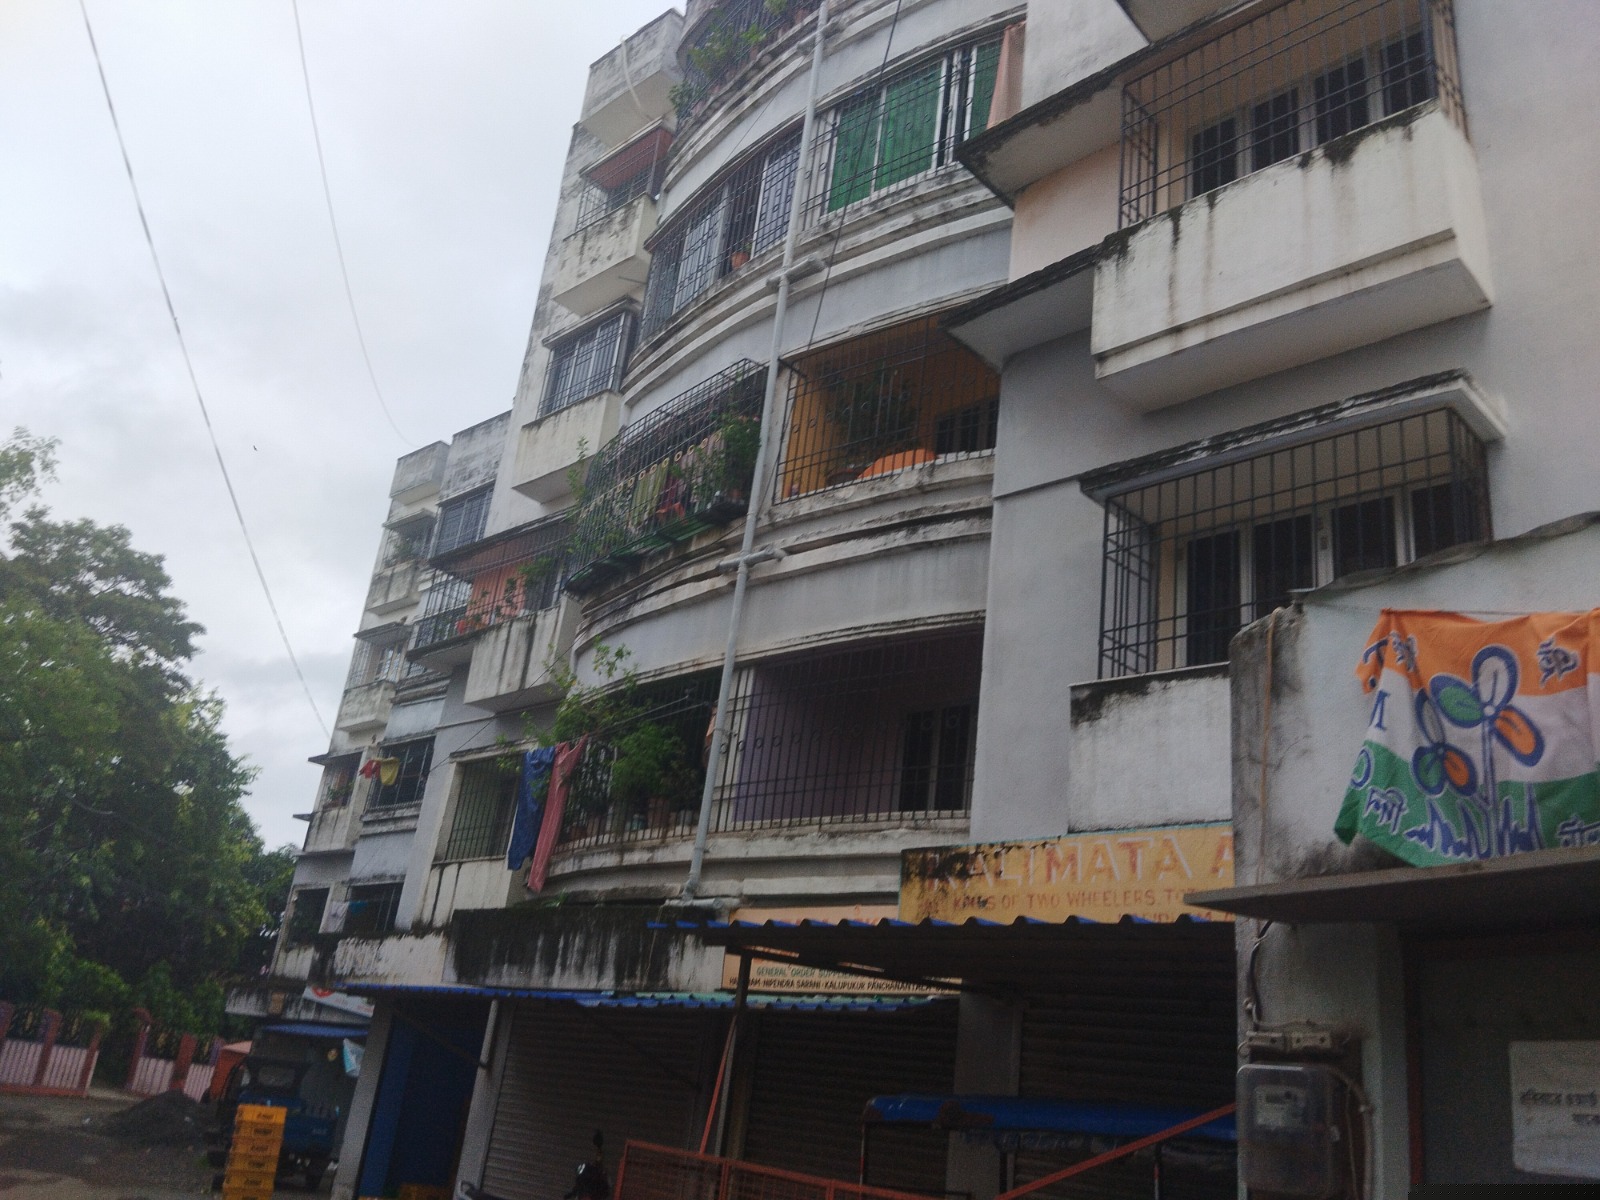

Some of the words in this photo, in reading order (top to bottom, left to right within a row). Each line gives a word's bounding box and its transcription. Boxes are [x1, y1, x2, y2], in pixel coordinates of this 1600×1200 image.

[1027, 892, 1061, 909] TWO
[757, 966, 787, 977] GENERAL
[790, 967, 816, 978] ORDER
